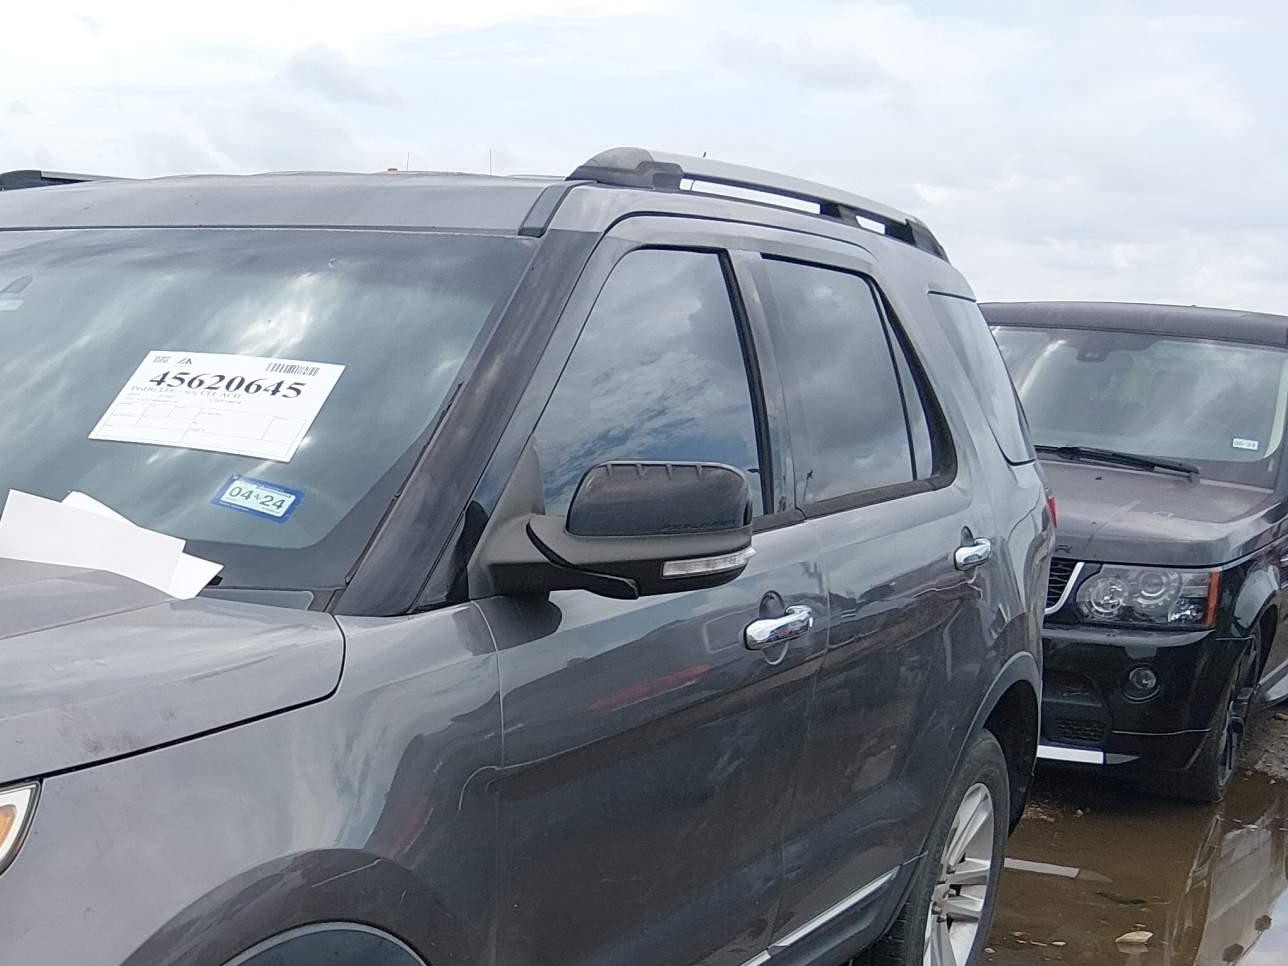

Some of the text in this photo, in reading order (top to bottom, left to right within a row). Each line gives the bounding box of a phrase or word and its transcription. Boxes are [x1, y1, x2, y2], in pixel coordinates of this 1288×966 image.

[149, 370, 308, 399] 45620645
[229, 486, 286, 510] 04 24
